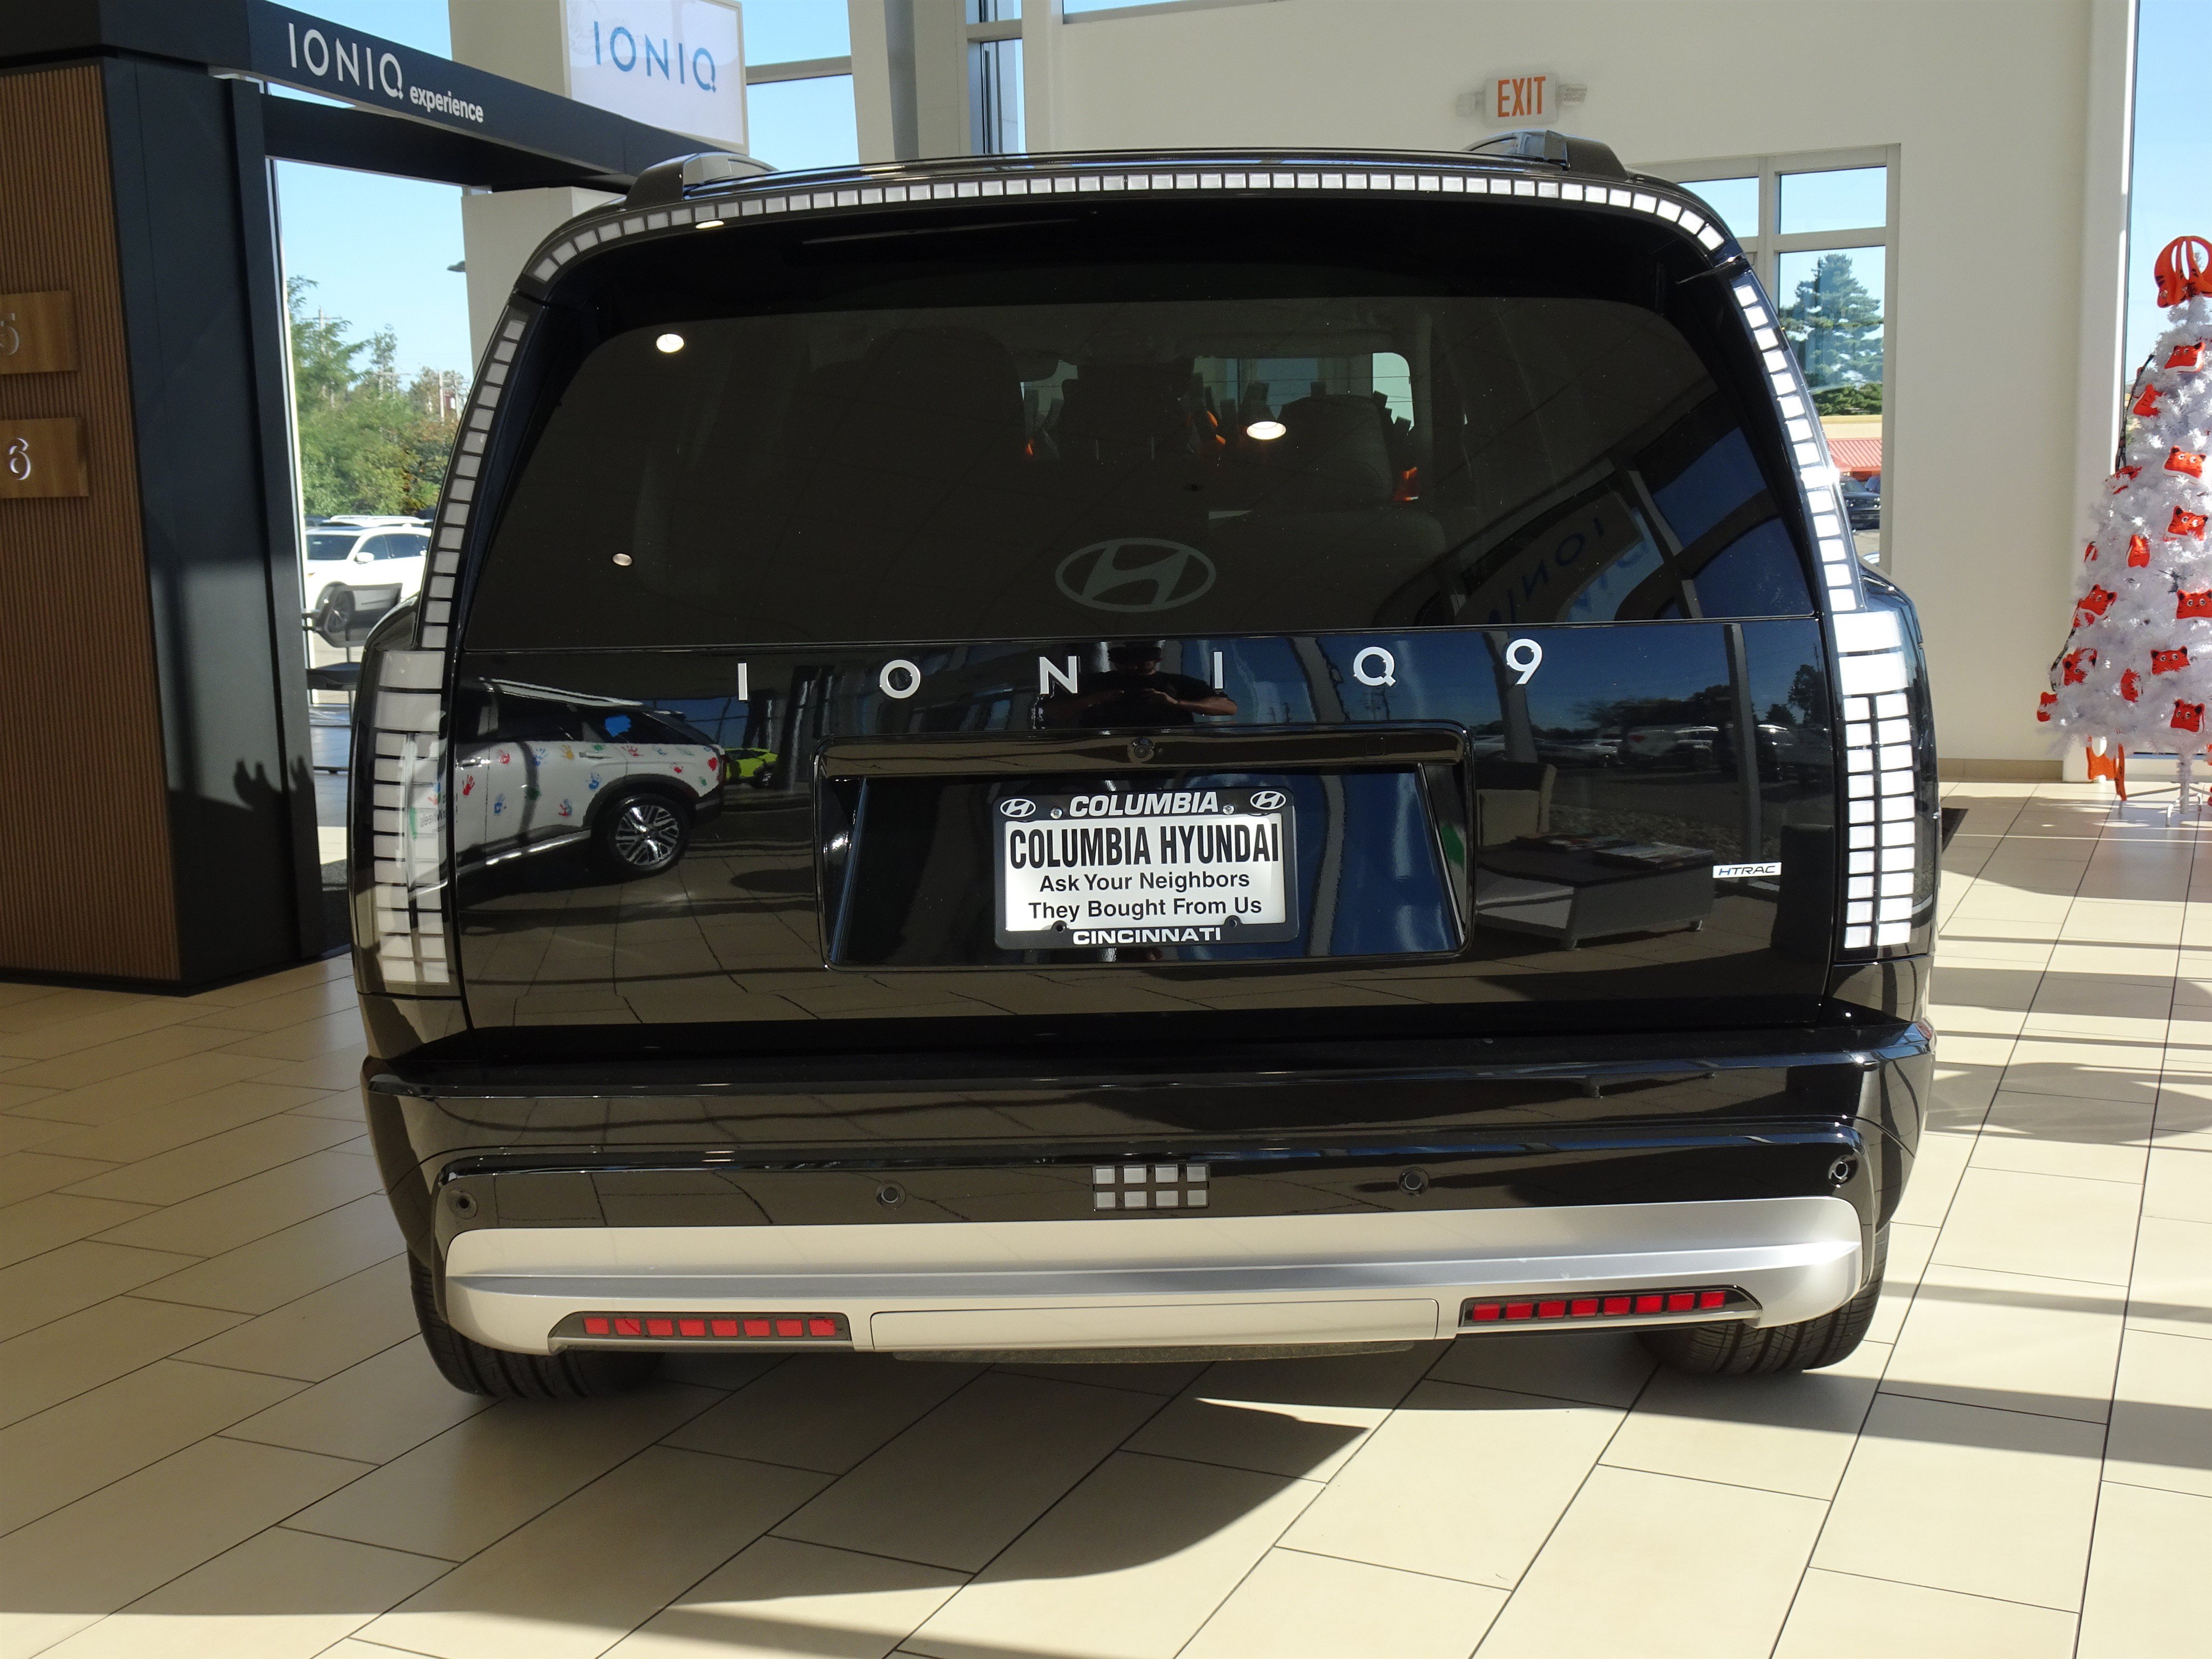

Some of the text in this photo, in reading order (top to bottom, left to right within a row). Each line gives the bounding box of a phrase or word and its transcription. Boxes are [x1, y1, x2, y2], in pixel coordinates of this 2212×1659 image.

[288, 23, 484, 123] IONIQ experience
[594, 21, 716, 93] IONIQ
[1498, 76, 1546, 117] EXIT
[9, 438, 31, 480] 6
[1506, 638, 1543, 685] 9
[1069, 791, 1218, 817] COLUMBIA
[1010, 824, 1279, 869] COLUMBIA HYUNDAI
[1040, 871, 1250, 893] Ask Your Neighbors
[1718, 866, 1776, 875] HTRAC
[1028, 896, 1262, 922] They Bought From Us
[1073, 927, 1220, 945] CINCINNATI
